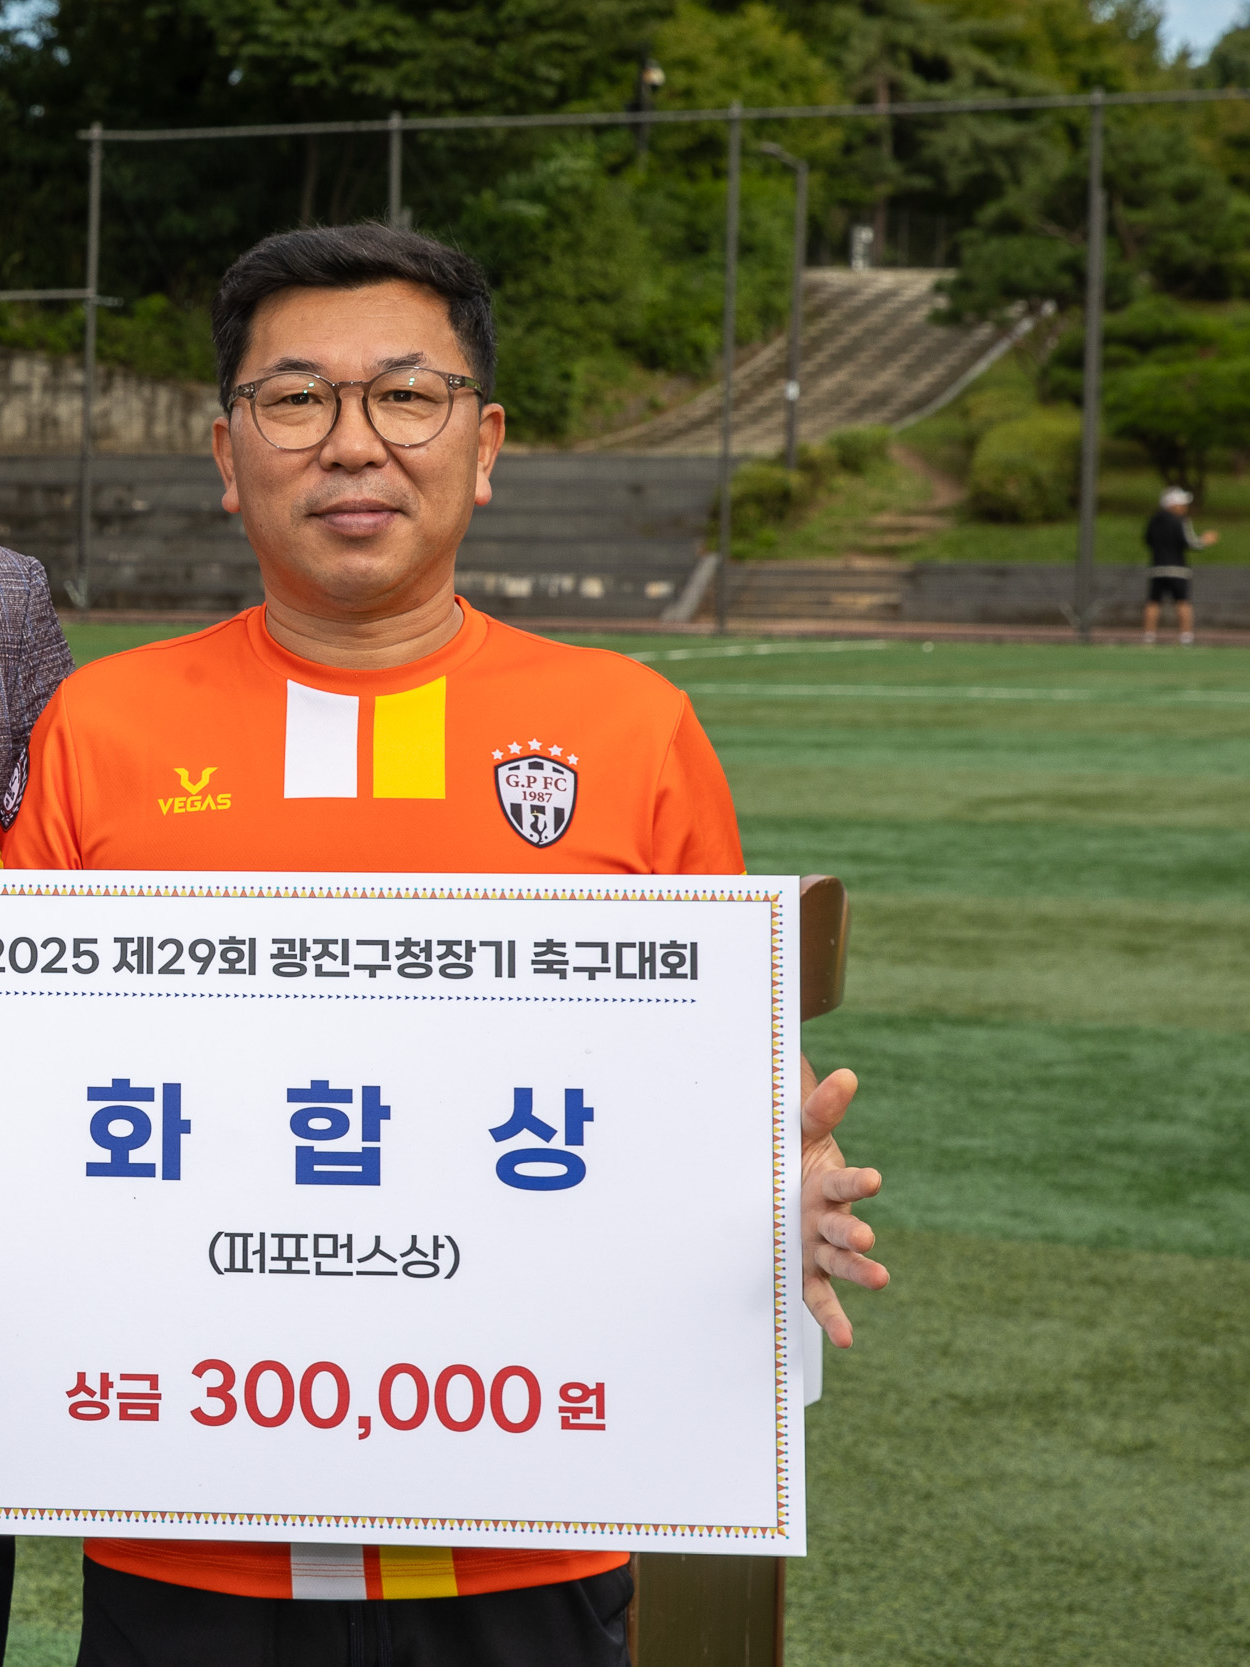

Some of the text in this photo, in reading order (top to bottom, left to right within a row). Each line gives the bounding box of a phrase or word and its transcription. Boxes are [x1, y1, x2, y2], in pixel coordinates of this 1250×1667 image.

[505, 773, 568, 792] G.P FC
[521, 790, 553, 803] 1987
[157, 793, 232, 816] VEGAS
[112, 936, 257, 976] 제29회
[269, 937, 516, 980] 광진구청장기
[530, 939, 699, 981] 축구대회
[208, 1231, 461, 1280] (퍼포먼스상)
[65, 1358, 607, 1441] 상금 300,000 원
